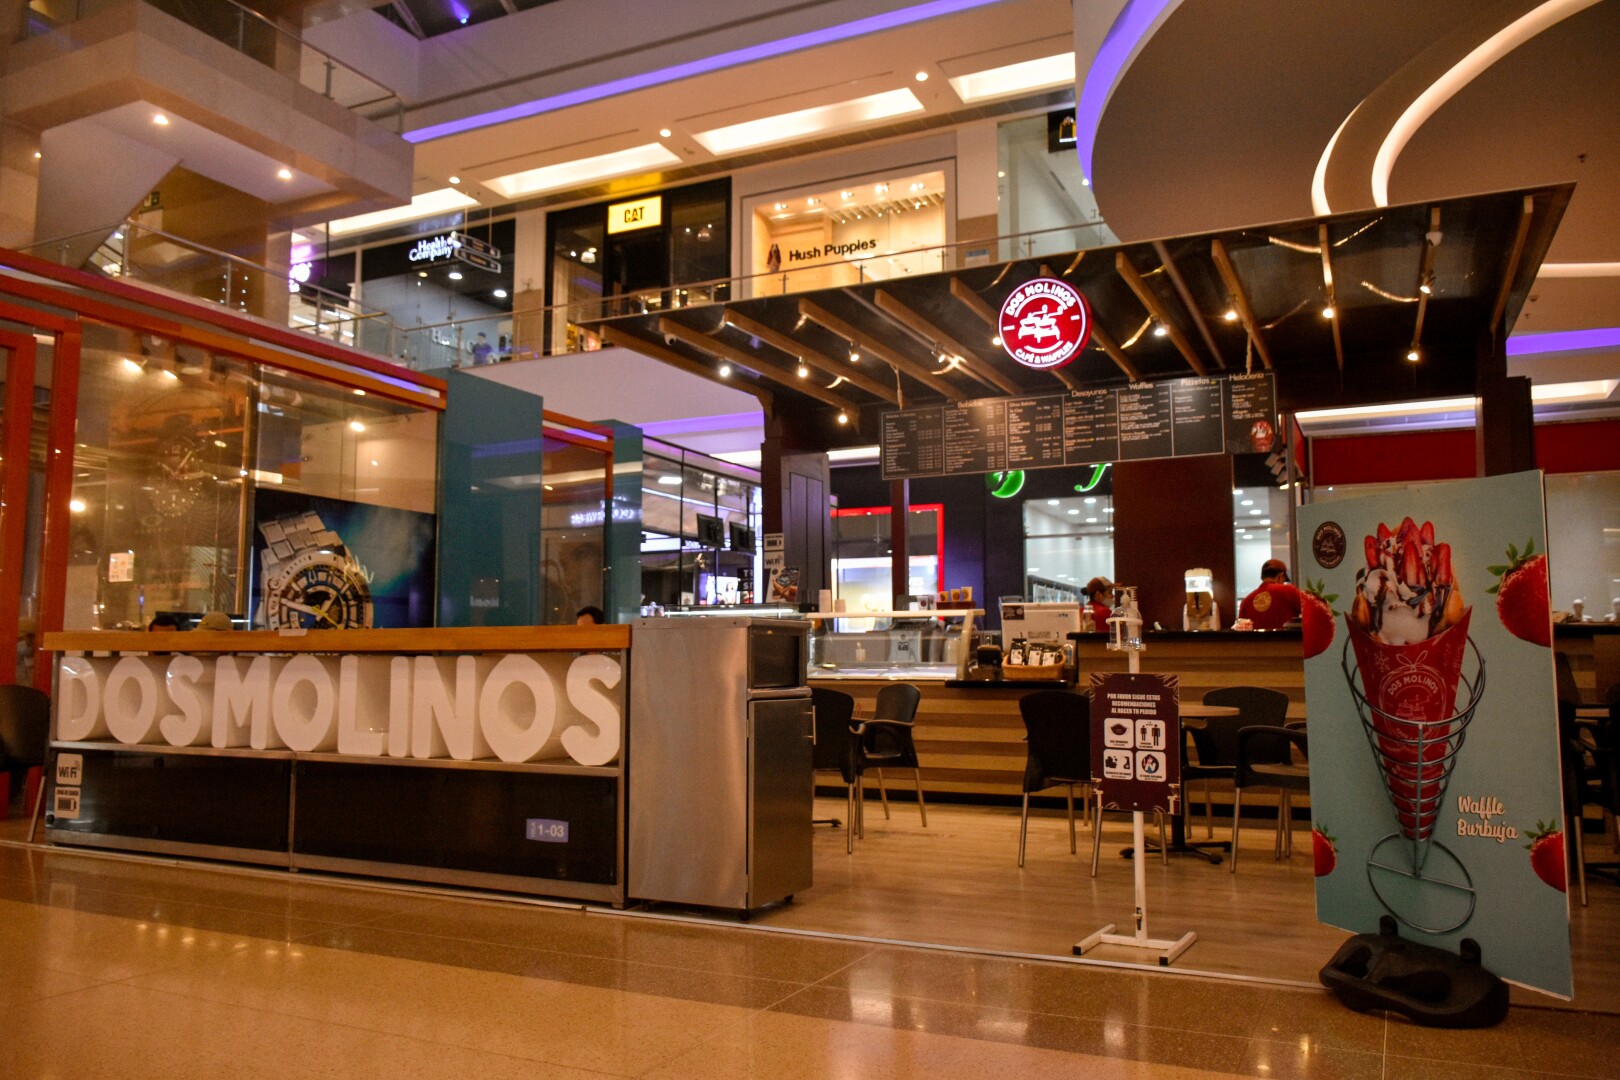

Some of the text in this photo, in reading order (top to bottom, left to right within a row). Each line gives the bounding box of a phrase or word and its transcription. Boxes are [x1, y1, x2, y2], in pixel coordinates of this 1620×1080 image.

[624, 206, 645, 223] CAT
[409, 245, 454, 261] Company
[417, 235, 448, 251] Health
[789, 239, 877, 262] Hush Puppies
[1005, 283, 1076, 316] DOS MOLINOS
[1388, 675, 1439, 695] DOS MOLINOS
[1457, 795, 1506, 820] Waffle
[538, 823, 565, 838] 1-03
[1457, 818, 1519, 843] Burbuja
